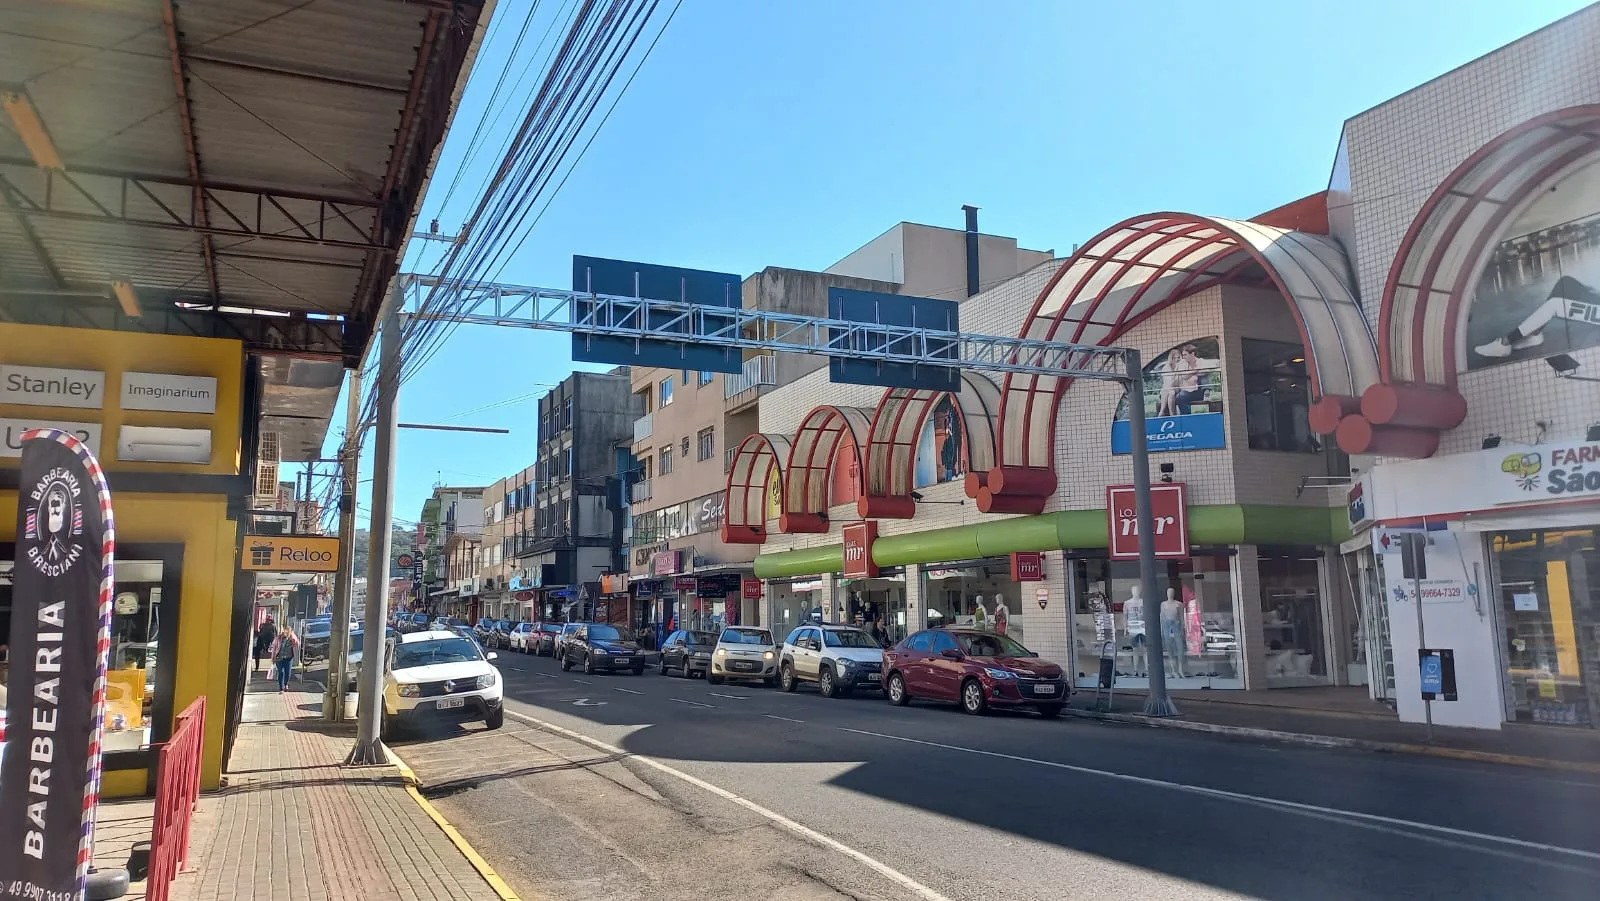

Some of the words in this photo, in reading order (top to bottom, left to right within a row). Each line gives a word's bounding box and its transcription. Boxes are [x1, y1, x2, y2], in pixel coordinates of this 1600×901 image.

[6, 373, 97, 400] Stanley
[128, 384, 210, 399] Imaginarium
[1146, 431, 1193, 441] EGADA
[31, 467, 81, 501] BARBEARIA
[1546, 465, 1600, 494] São
[27, 543, 83, 576] BRESCIANI
[280, 547, 332, 562] Reloo
[24, 600, 66, 860] BARBEARIA
[9, 880, 22, 896] 49
